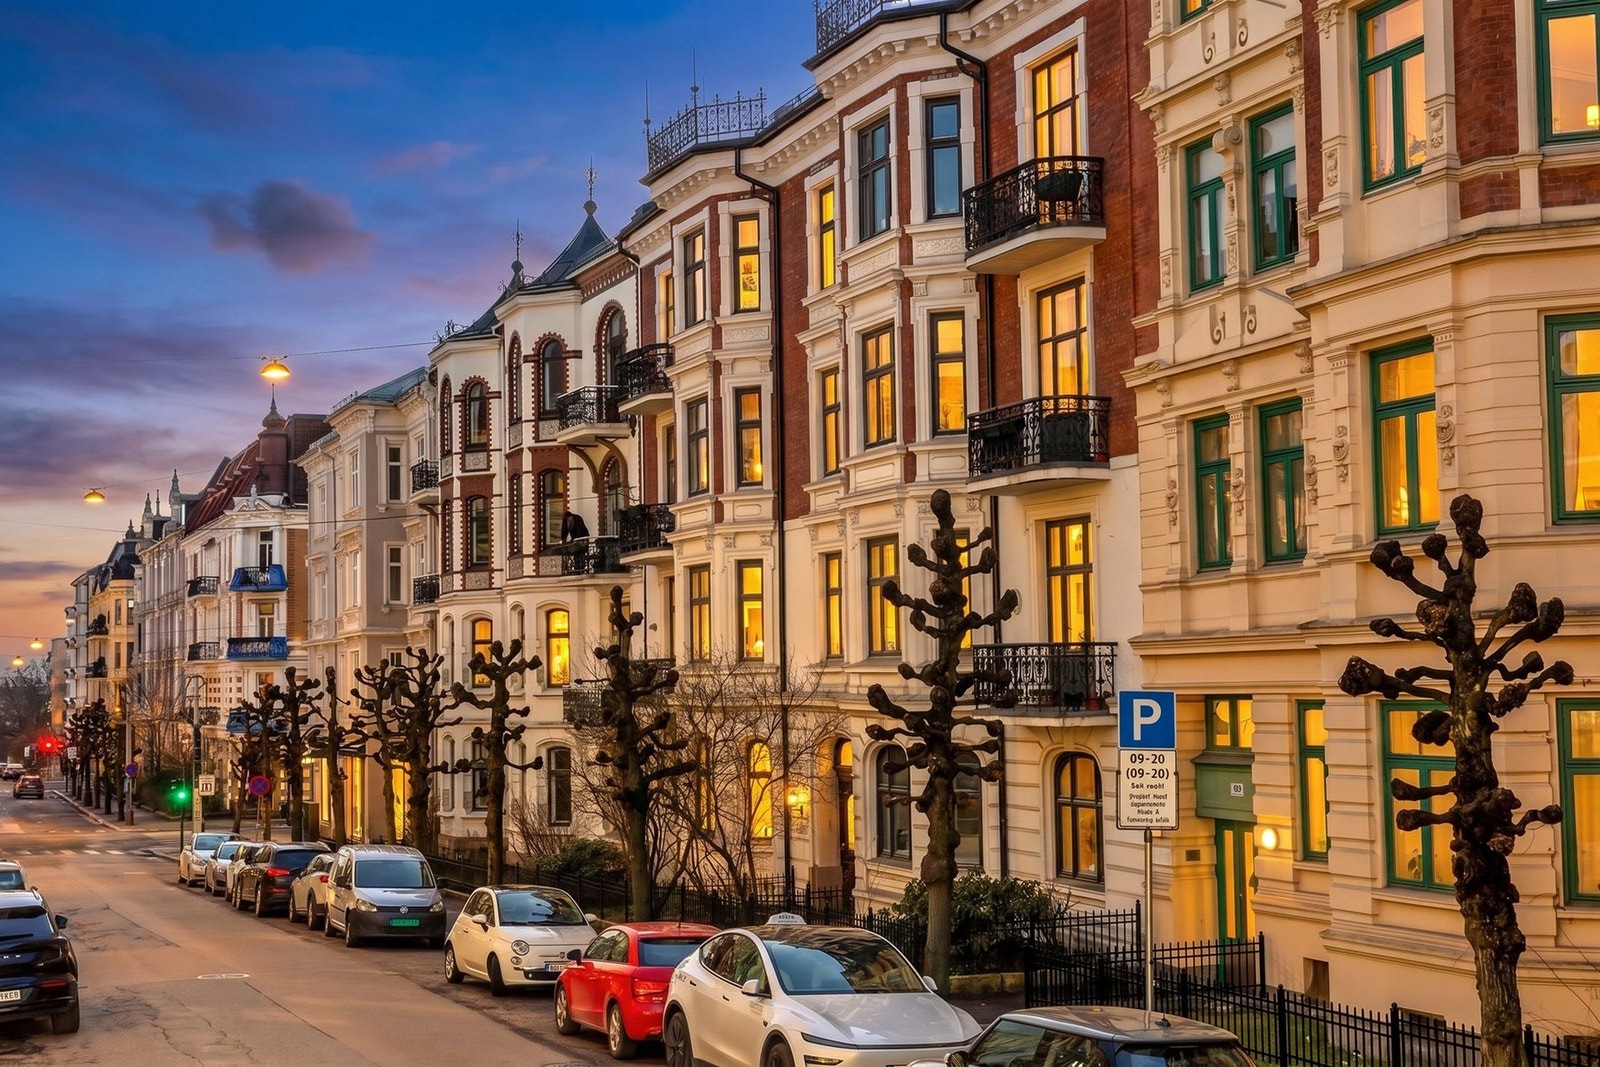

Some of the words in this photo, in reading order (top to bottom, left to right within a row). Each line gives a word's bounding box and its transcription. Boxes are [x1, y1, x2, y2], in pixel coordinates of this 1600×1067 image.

[1133, 699, 1162, 741] P
[1130, 753, 1165, 764] 09-20
[1126, 768, 1170, 780] (09-20)
